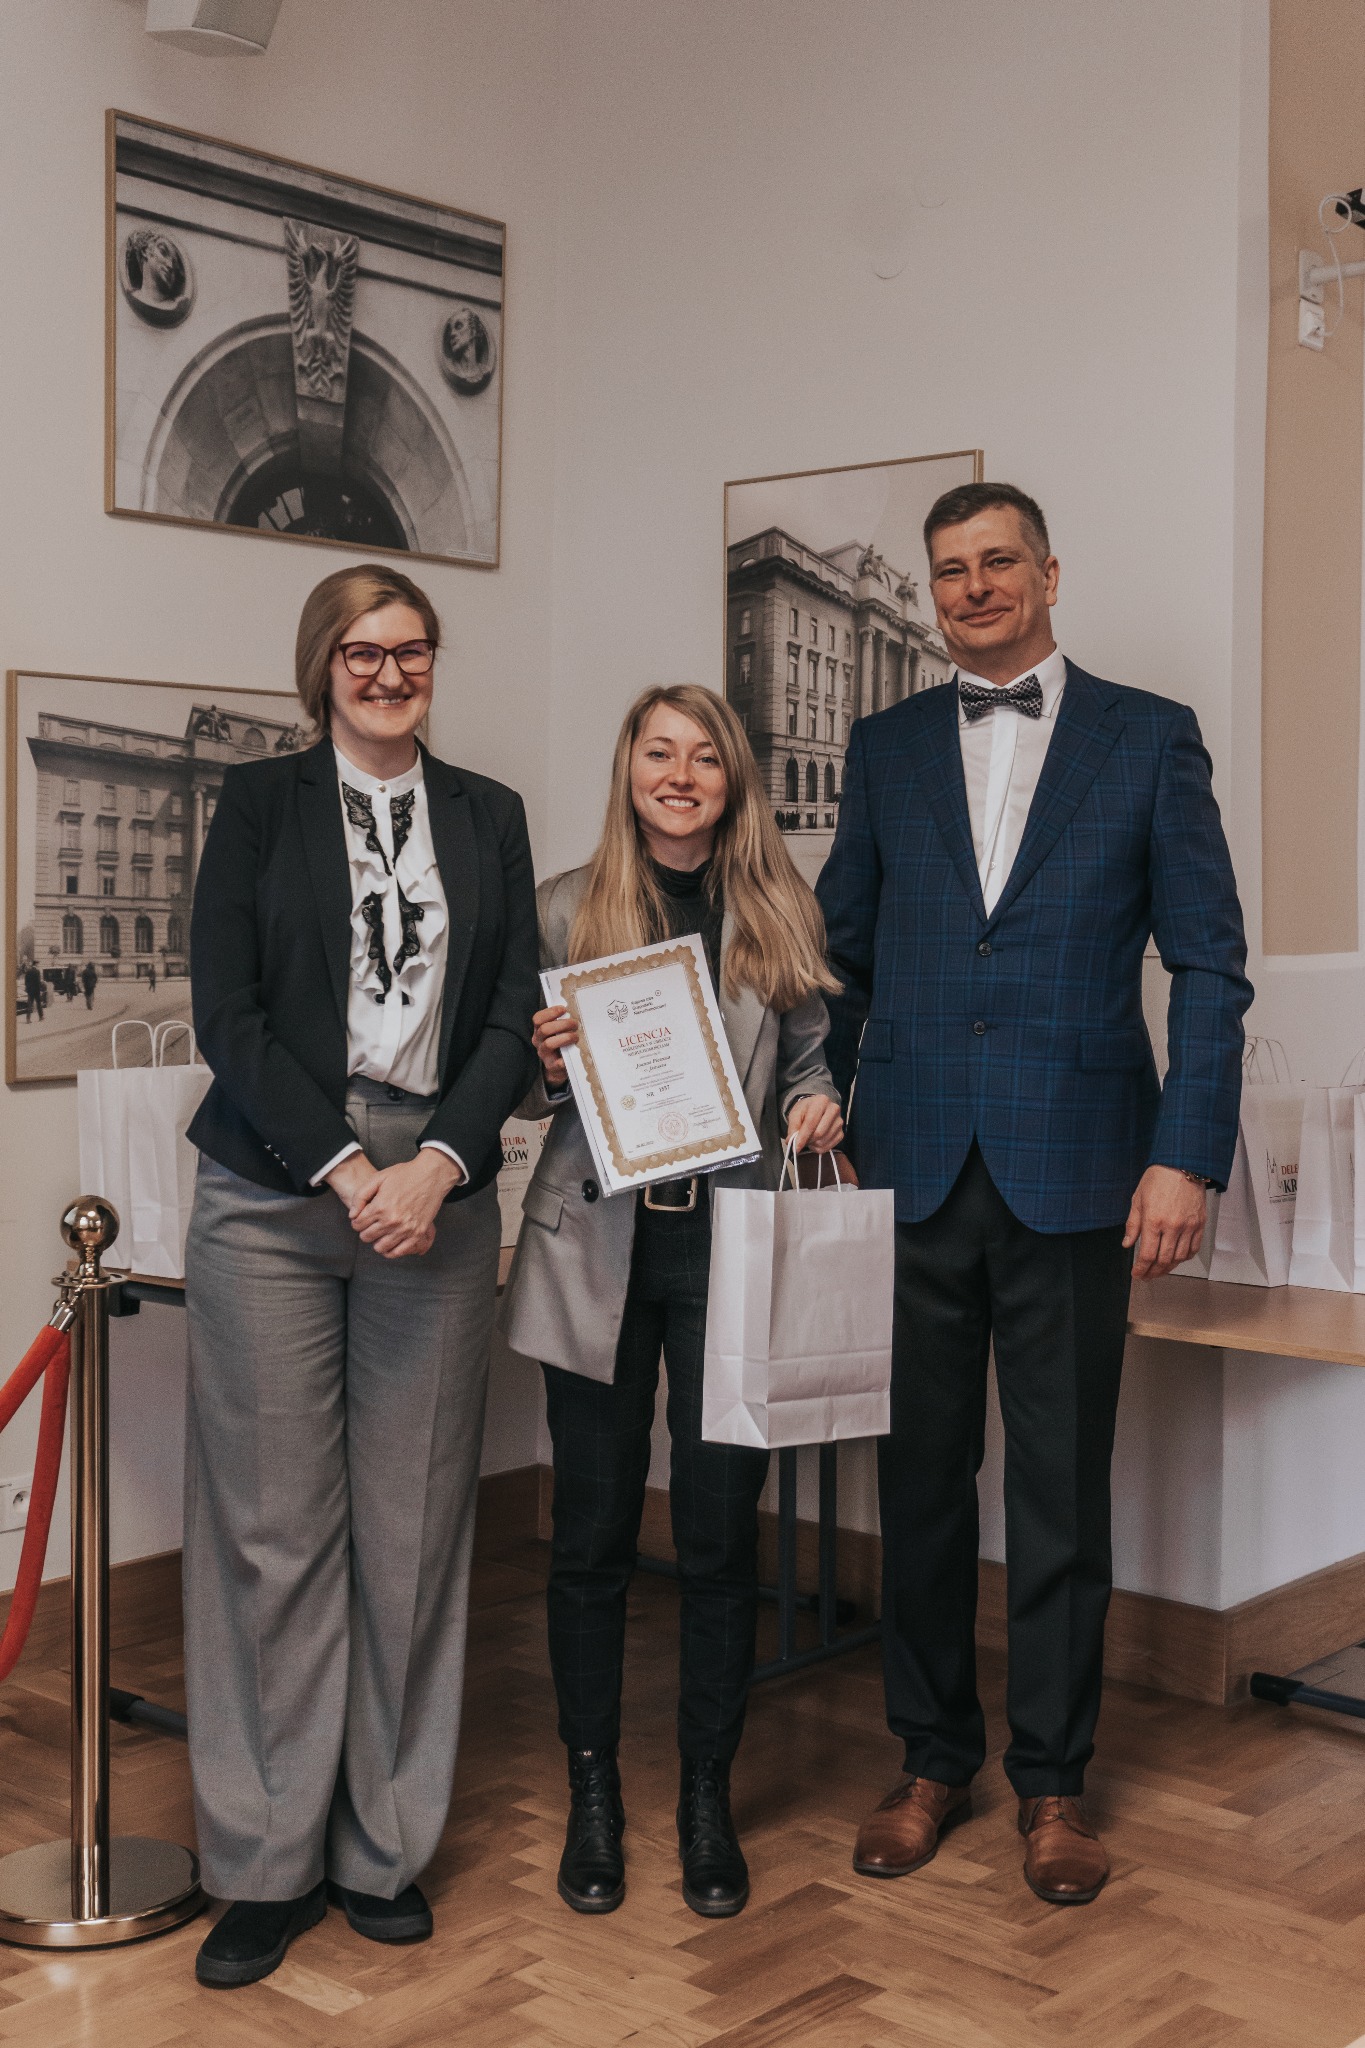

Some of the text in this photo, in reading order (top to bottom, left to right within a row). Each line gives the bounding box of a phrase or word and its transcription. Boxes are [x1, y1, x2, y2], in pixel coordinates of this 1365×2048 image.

[618, 1026, 672, 1048] LICENCJA
[501, 1136, 527, 1147] TURA
[1281, 1164, 1298, 1175] DELE
